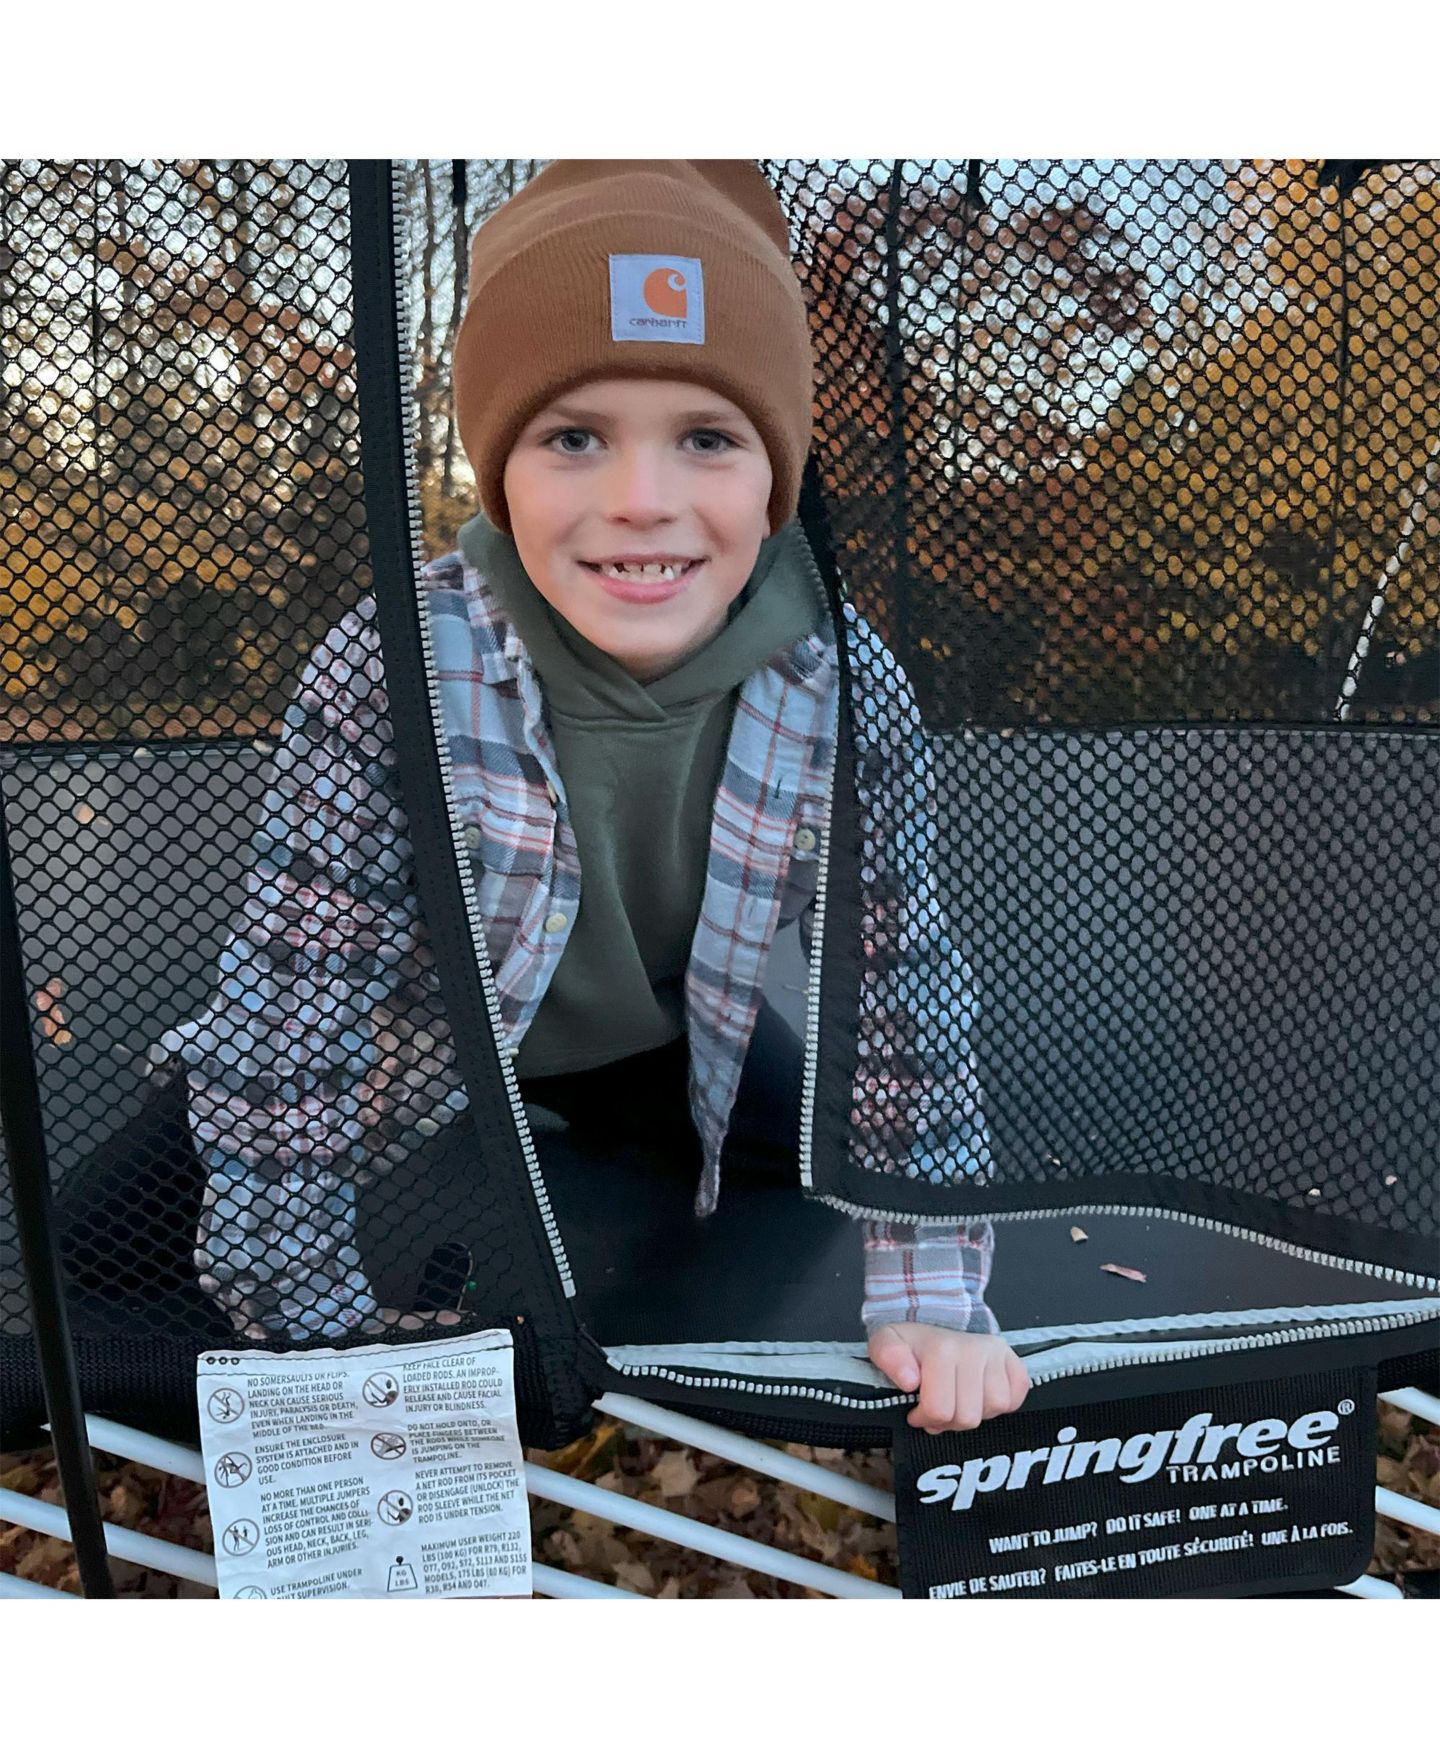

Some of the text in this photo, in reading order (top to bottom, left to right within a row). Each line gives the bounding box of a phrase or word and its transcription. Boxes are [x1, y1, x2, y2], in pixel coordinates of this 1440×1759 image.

[442, 1358, 464, 1368] CLEAR
[261, 1375, 312, 1386] SOMERSAULTS
[403, 1372, 431, 1383] LOADED
[404, 1379, 503, 1393] ERLY INSTALLED ROD COULD
[248, 1381, 343, 1398] LANDING ON THE HEAD OR
[405, 1390, 501, 1402] RELEASE AND CAUSE FACIAL
[249, 1393, 344, 1408] NECK CAN CAUSE SERIOUS
[251, 1402, 358, 1418] INJURY, PARALYSIS DEATH,
[406, 1401, 486, 1413] INJURY BLINDNESS.
[252, 1411, 353, 1429] EVEN WHEN LANDING IN THE
[253, 1425, 308, 1438] MIDDLE THE
[255, 1434, 346, 1454] ENSURE THE ENCLOSURE
[256, 1443, 349, 1464] SYSTEM ATTACHED AND
[258, 1452, 352, 1474] GOOD CONDITION BEFORE
[413, 1452, 462, 1463] TRAMPOLINE.
[1166, 1445, 1342, 1485] TRAMPOLINE
[259, 1475, 276, 1485] USE.
[416, 1461, 512, 1479] NEVER ATTEMPT TO REMOVE
[423, 1469, 516, 1490] NET ROD FROM ITS POCKET
[261, 1477, 364, 1502] NO MORE THAN ONE PERSON
[417, 1478, 519, 1501] OR DISENGAGE (UNLOCK) THE
[262, 1504, 270, 1513] AT
[300, 1493, 334, 1506] MULTIPLE
[337, 1487, 370, 1500] JUMPERS
[418, 1490, 514, 1513] ROD SLEEVE WHILE THE NET
[263, 1499, 360, 1524] INCREASE THE CHANCES OF
[419, 1504, 503, 1524] ROD UNDER TENSION.
[264, 1524, 282, 1535] LOSS
[284, 1523, 294, 1532] OF
[296, 1517, 329, 1529] CONTROL
[331, 1514, 346, 1523] AND
[266, 1535, 283, 1546] SION
[285, 1532, 299, 1542] AND
[302, 1529, 316, 1539] CAN
[318, 1524, 344, 1536] RESULT
[346, 1523, 354, 1531] IN
[989, 1497, 1288, 1553] WANT TO JUMP? DO IT SAFE! ONE AT A TIME.
[267, 1530, 369, 1557] OUS HEAD, NECK, BACK, LEG,
[421, 1531, 520, 1551] MAXIMUM USER WEIGHT 220
[268, 1542, 358, 1568] ARM OR OTHER INJURIES.
[495, 1556, 509, 1565] AND
[929, 1580, 967, 1599] ENVIE
[969, 1576, 987, 1594] DE
[989, 1567, 1046, 1591] SAUTER?
[1054, 1556, 1117, 1582] FAITES-LE
[1117, 1553, 1136, 1569] EN
[1138, 1544, 1181, 1566] TOUTE
[1261, 1529, 1288, 1546] UNE
[1302, 1526, 1318, 1540] LA
[1320, 1521, 1353, 1538] FOIS.
[271, 1568, 362, 1596] USE TRAMPOLINE UNDER
[297, 1582, 349, 1599] SUPERVISION.
[458, 1581, 472, 1590] AND
